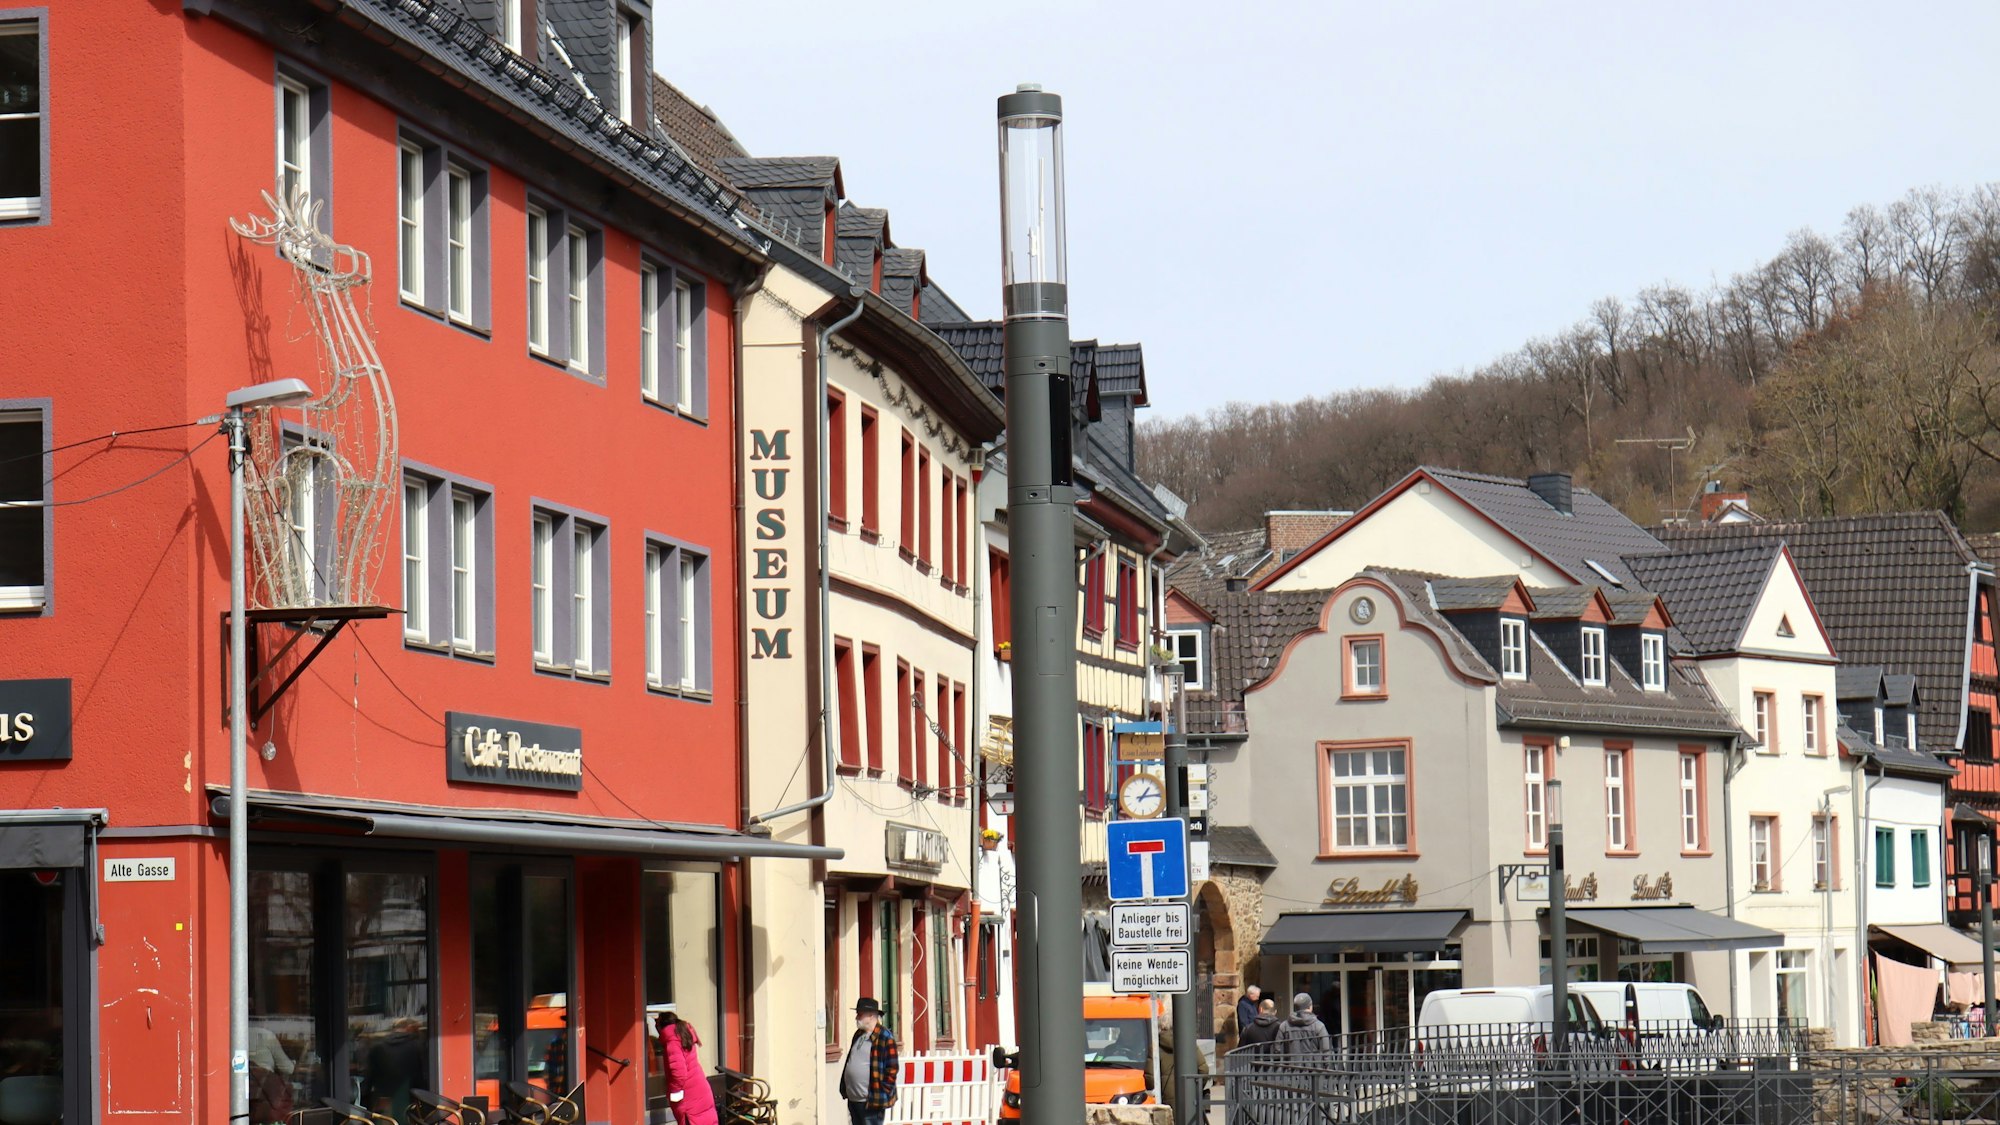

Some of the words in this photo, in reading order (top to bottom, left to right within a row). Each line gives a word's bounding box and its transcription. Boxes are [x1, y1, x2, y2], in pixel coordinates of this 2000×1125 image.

[749, 429, 792, 660] MUSEUM
[111, 864, 132, 878] Alte
[138, 863, 169, 877] Gasse
[1121, 913, 1161, 926] Anlieger
[1166, 911, 1180, 923] bis
[1118, 927, 1162, 939] Baustelle
[1166, 926, 1183, 938] frei
[1117, 959, 1142, 970] keine
[1147, 958, 1184, 970] Wende-
[1123, 973, 1179, 988] möglichkeit
